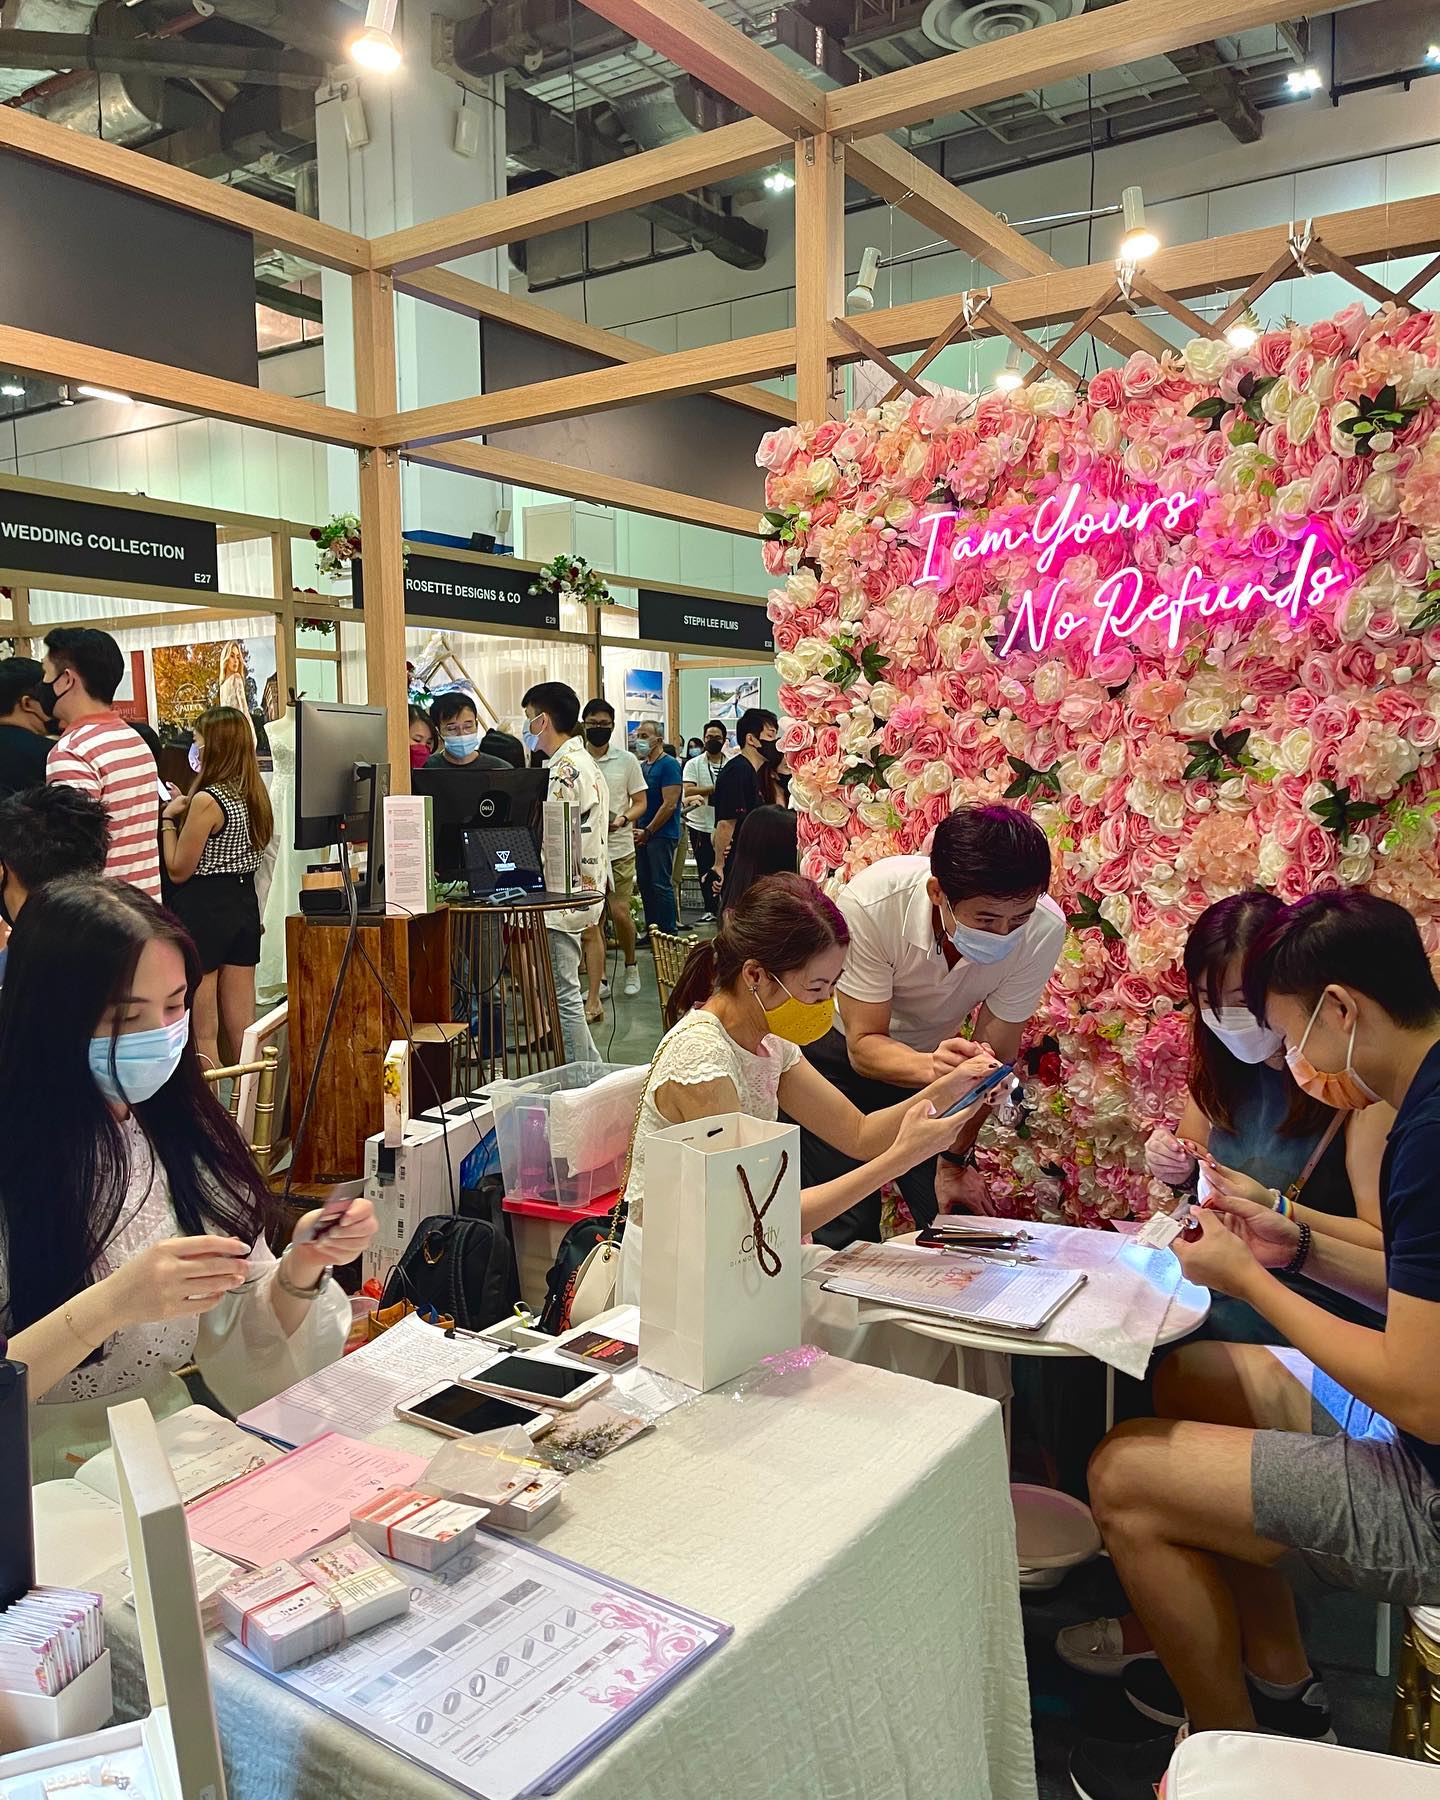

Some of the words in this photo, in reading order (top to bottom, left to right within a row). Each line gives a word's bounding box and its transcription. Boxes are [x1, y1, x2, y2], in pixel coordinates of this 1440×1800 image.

[1, 522, 83, 547] WEDDING
[87, 534, 185, 560] COLLECTION
[913, 511, 957, 587] I
[953, 526, 1024, 561] am
[1033, 483, 1197, 573] Yours
[194, 573, 211, 584] E27
[406, 578, 452, 595] ROSETTE
[455, 585, 496, 601] DESIGNS
[499, 591, 505, 602] &
[507, 592, 521, 604] CO
[1000, 578, 1086, 657] No
[1088, 533, 1346, 657] Refunds
[545, 616, 556, 625] E29
[683, 615, 706, 627] STEPH
[706, 618, 719, 628] LEE
[720, 620, 739, 630] FILMS
